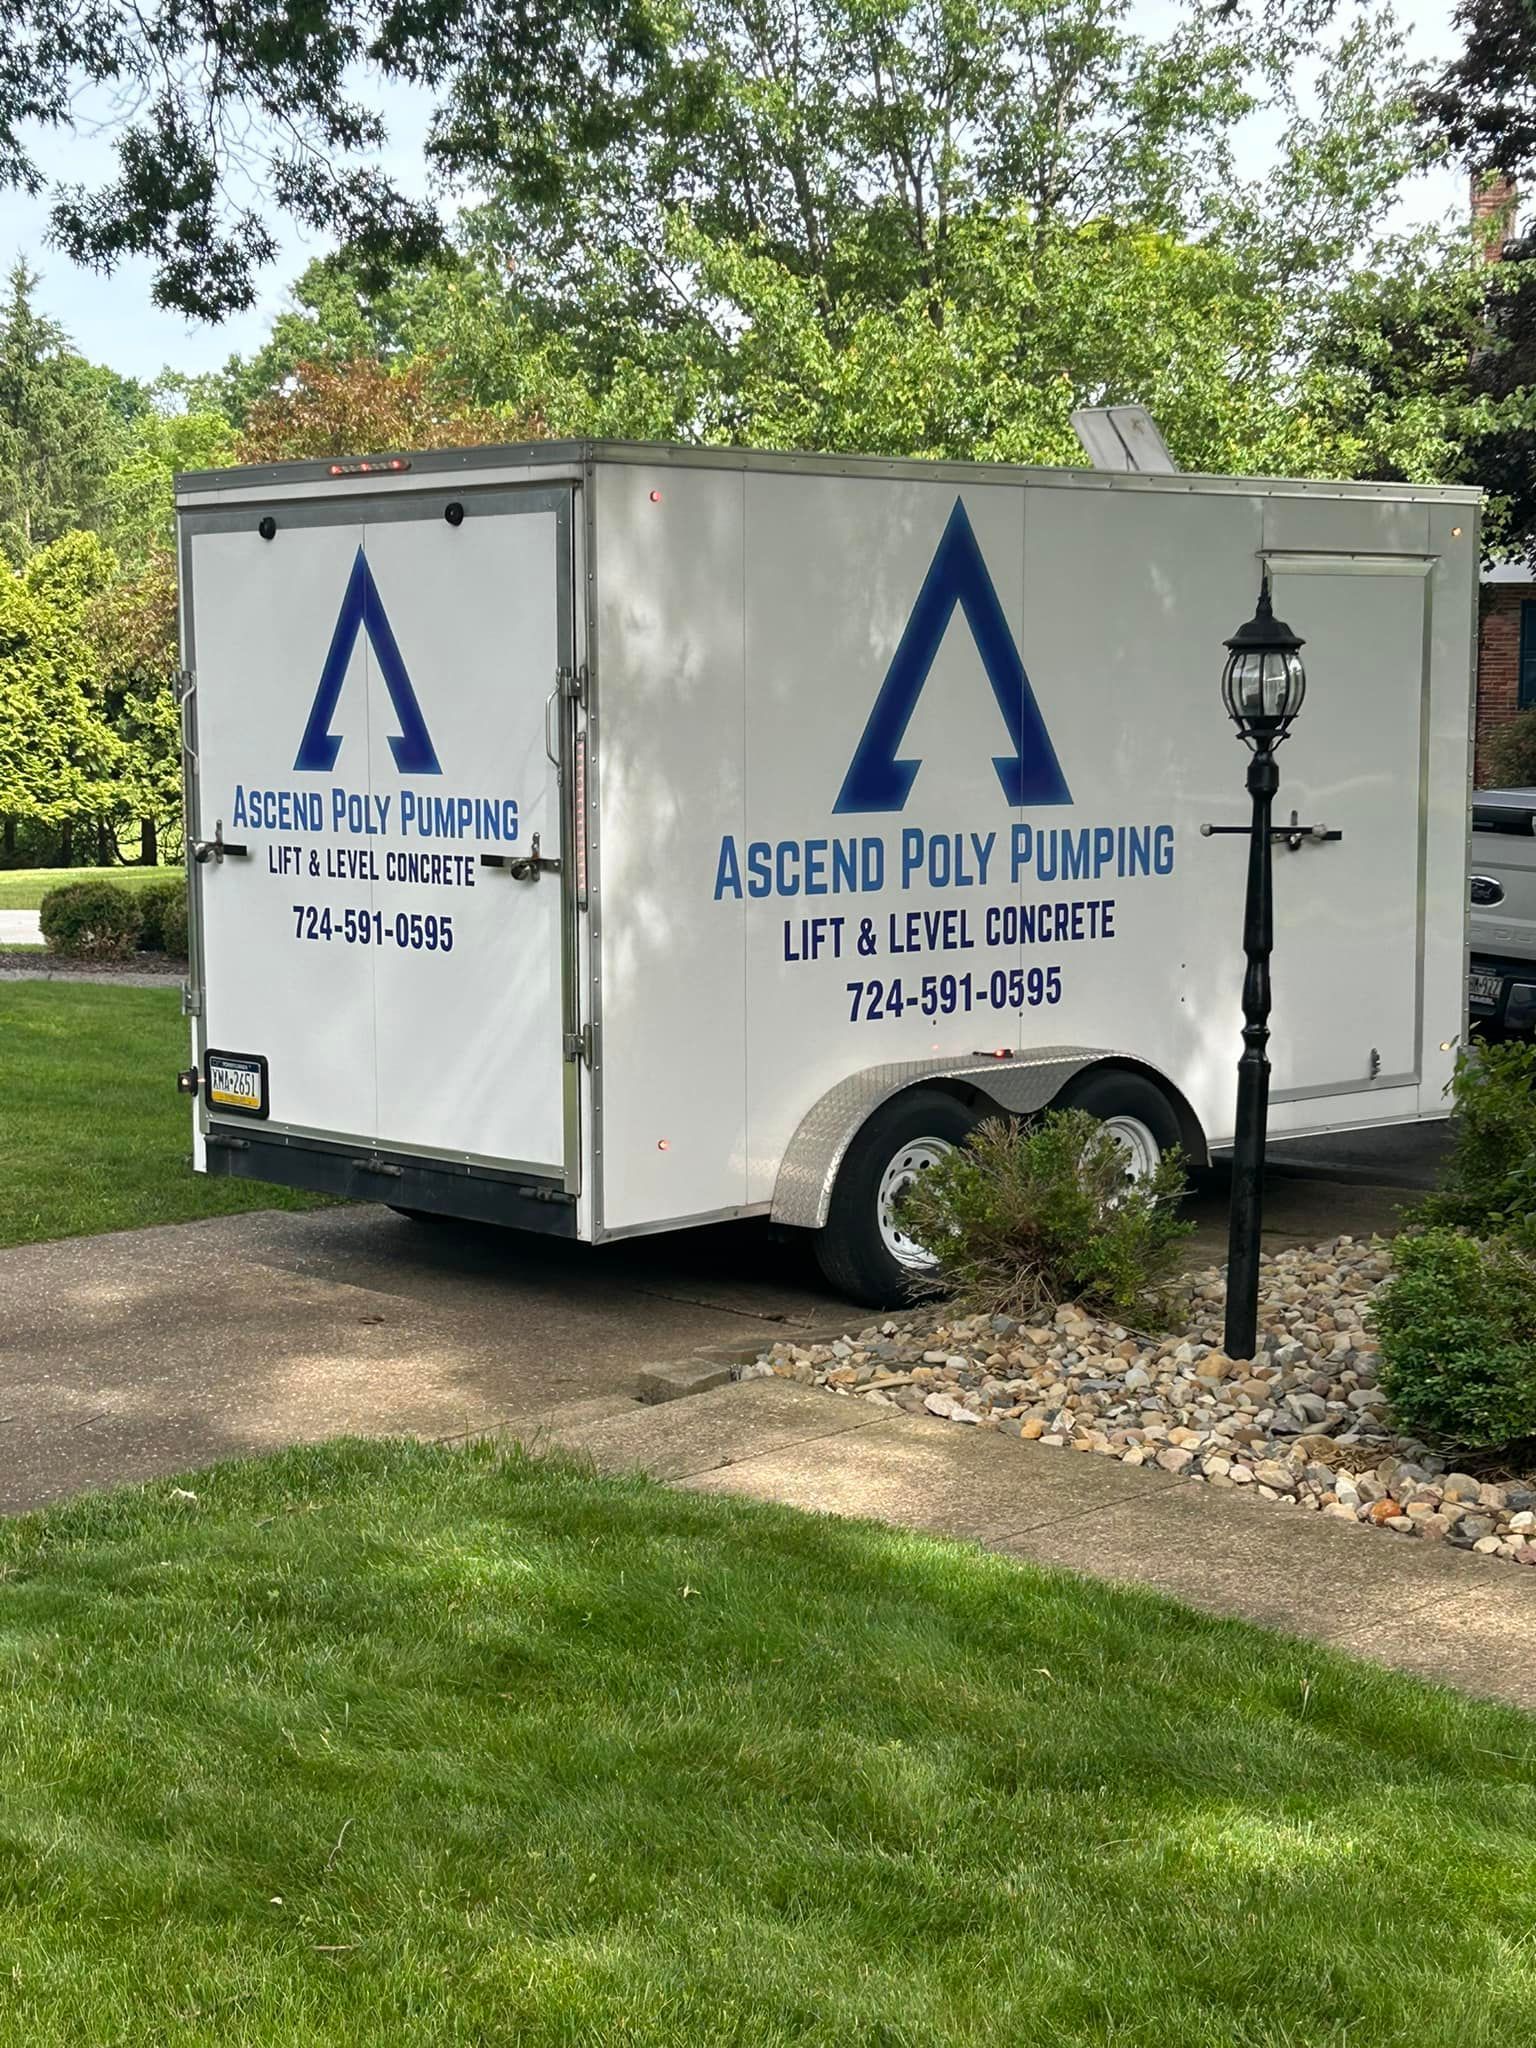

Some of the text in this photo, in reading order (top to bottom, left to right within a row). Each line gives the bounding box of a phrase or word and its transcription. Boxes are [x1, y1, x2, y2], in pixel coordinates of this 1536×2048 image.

[233, 786, 519, 841] ASCEND POLY PUMPING
[268, 845, 475, 887] LIFT & LEVEL CONCRETE
[713, 823, 1175, 900] ASCEND POLY PUMPING
[292, 905, 453, 952] 724-591-0595
[784, 900, 1116, 961] LIFT & LEVEL CONCRETE
[847, 966, 1062, 1022] 724-591-0595
